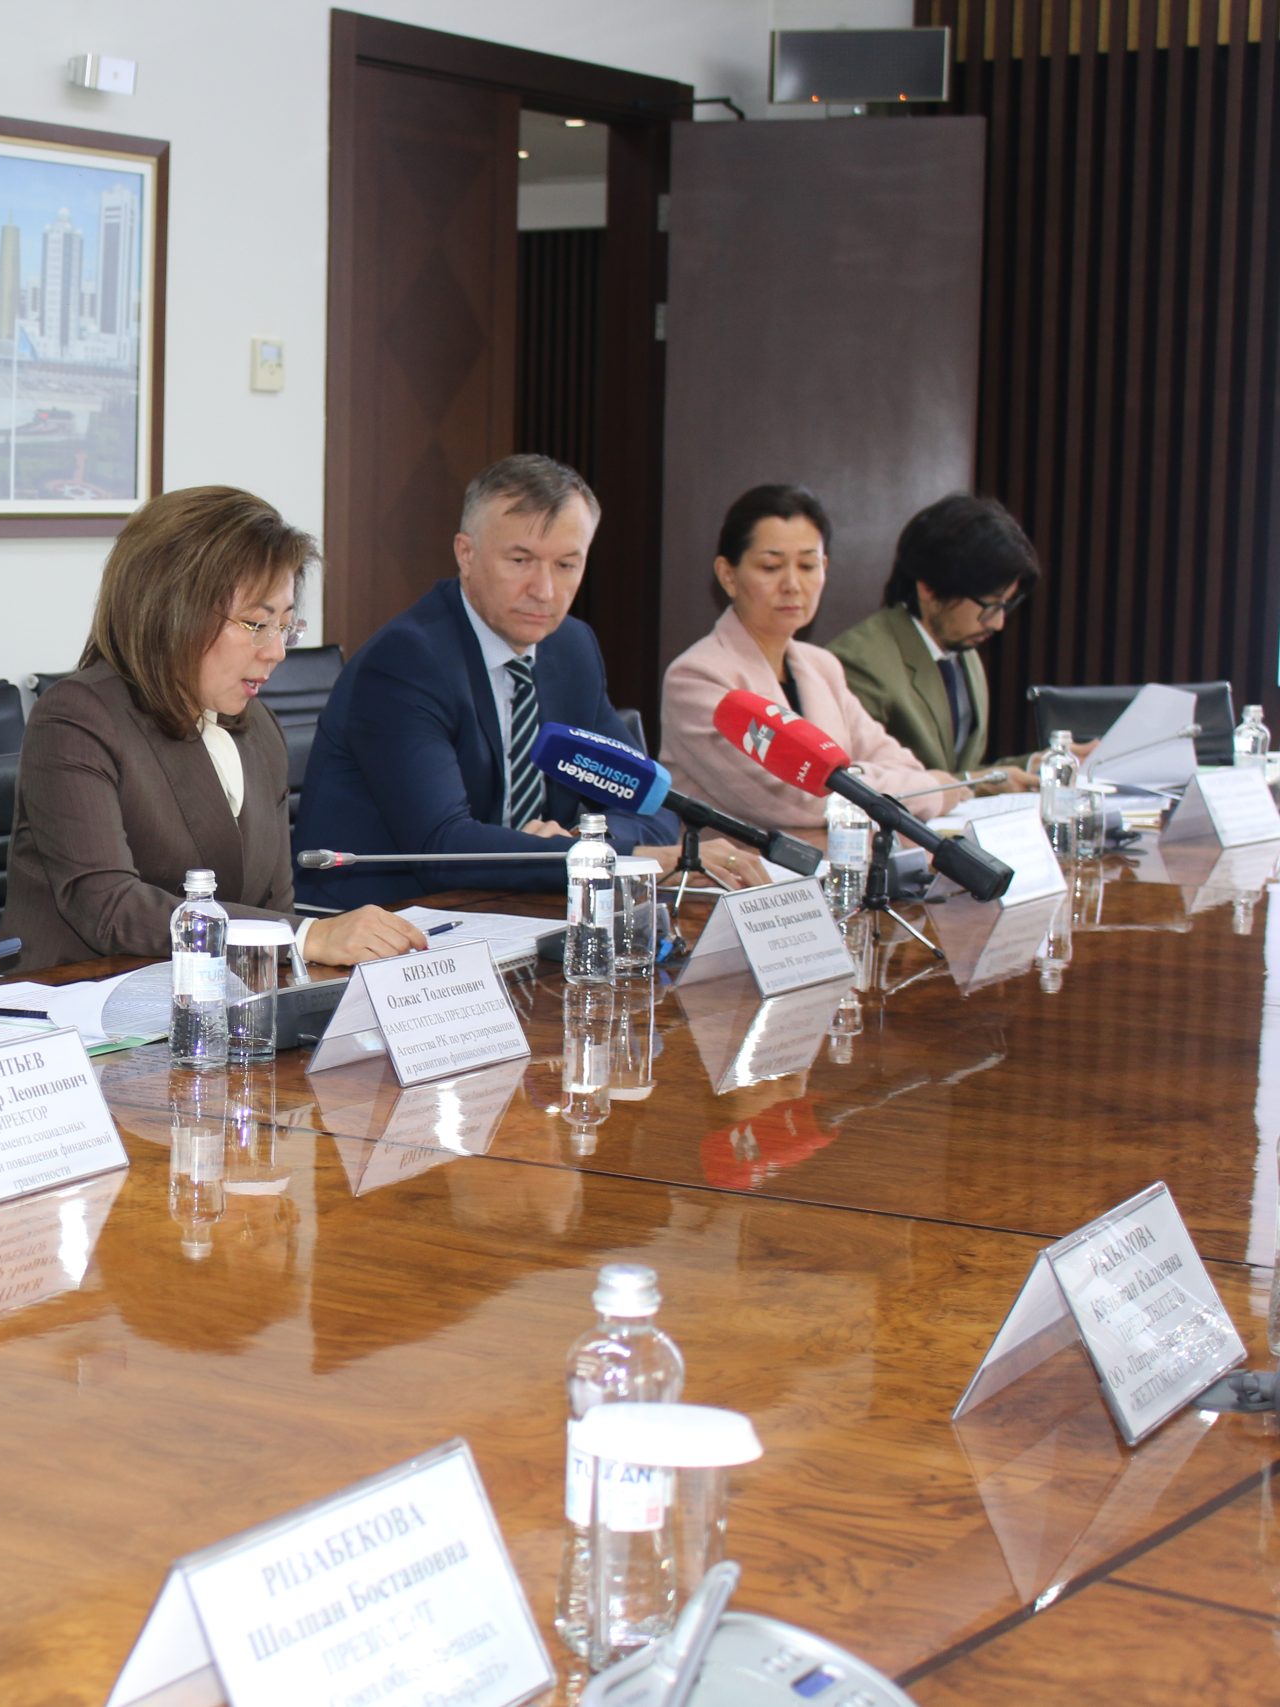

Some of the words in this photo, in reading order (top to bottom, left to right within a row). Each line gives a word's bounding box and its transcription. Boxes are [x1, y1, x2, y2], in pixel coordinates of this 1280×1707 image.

[557, 759, 635, 800] atameken
[572, 753, 640, 791] business
[402, 958, 455, 981] КИЗАТОВ
[386, 993, 421, 1008] Олжас
[421, 980, 484, 1001] Толегенович
[383, 1013, 445, 1035] ЗАМЕСТИТЕЛЬ
[444, 998, 506, 1020] ПРЕДСЕДАТЕЛЯ
[397, 1040, 436, 1057] Агентства
[435, 1034, 448, 1046] РК
[448, 1034, 459, 1043] по
[459, 1021, 514, 1044] регулированию
[412, 1056, 449, 1075] развитию
[9, 1074, 86, 1102] Леонидович
[33, 1121, 86, 1141] социальных
[6, 1148, 58, 1169] повышения
[59, 1131, 111, 1157] финансовой
[13, 1166, 71, 1191] грамотности
[248, 1601, 346, 1660] Шолпан
[348, 1541, 467, 1610] Бостановна
